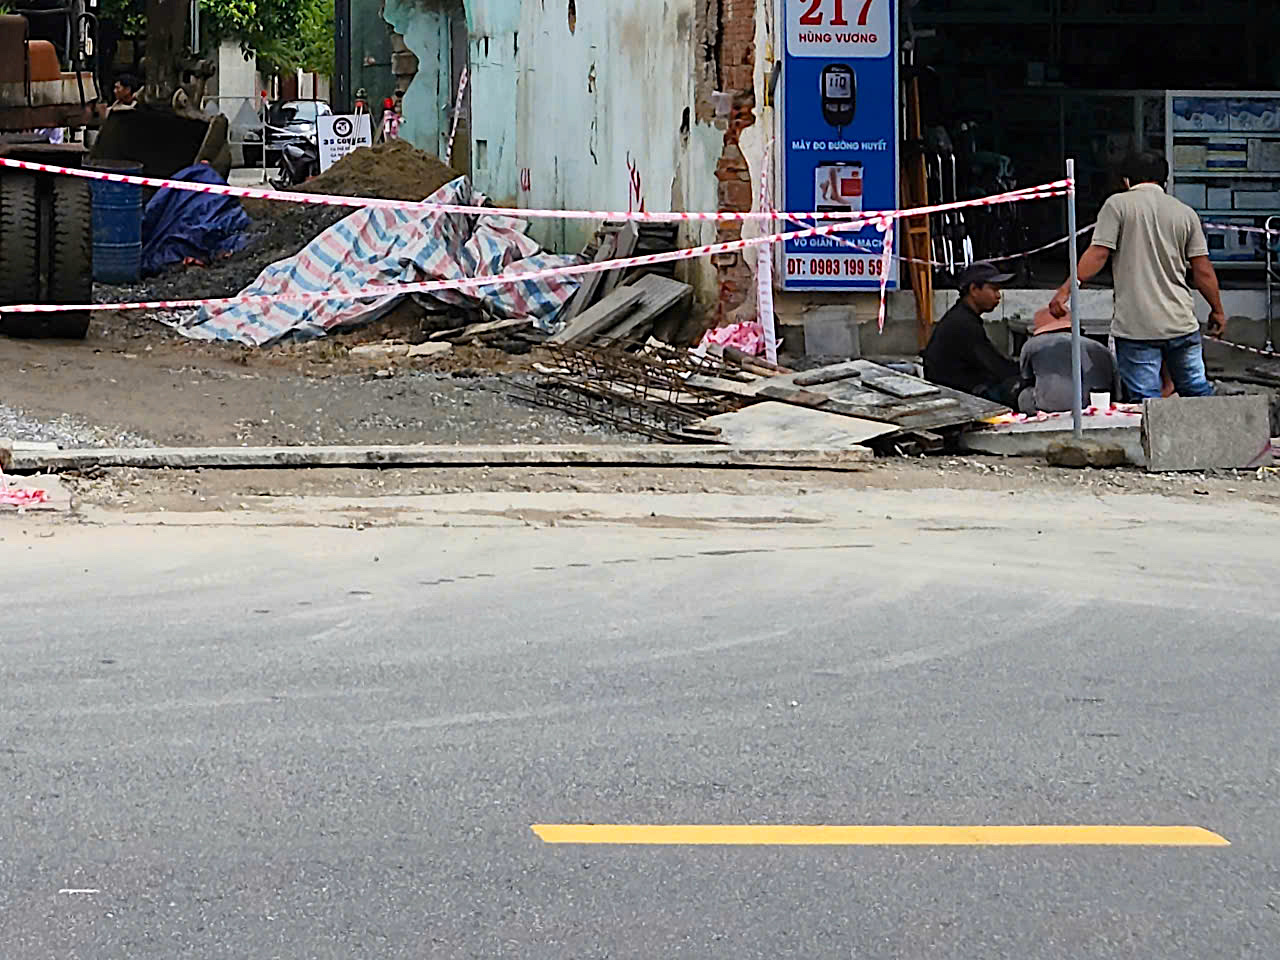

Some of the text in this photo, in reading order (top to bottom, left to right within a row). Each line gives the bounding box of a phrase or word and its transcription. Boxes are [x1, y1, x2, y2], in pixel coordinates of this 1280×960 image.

[799, 30, 878, 43] HÙNG VƯƠNG
[792, 139, 811, 150] MÁY
[861, 138, 887, 151] HUYẾT
[843, 258, 864, 276] 199
[868, 258, 884, 276] 59
